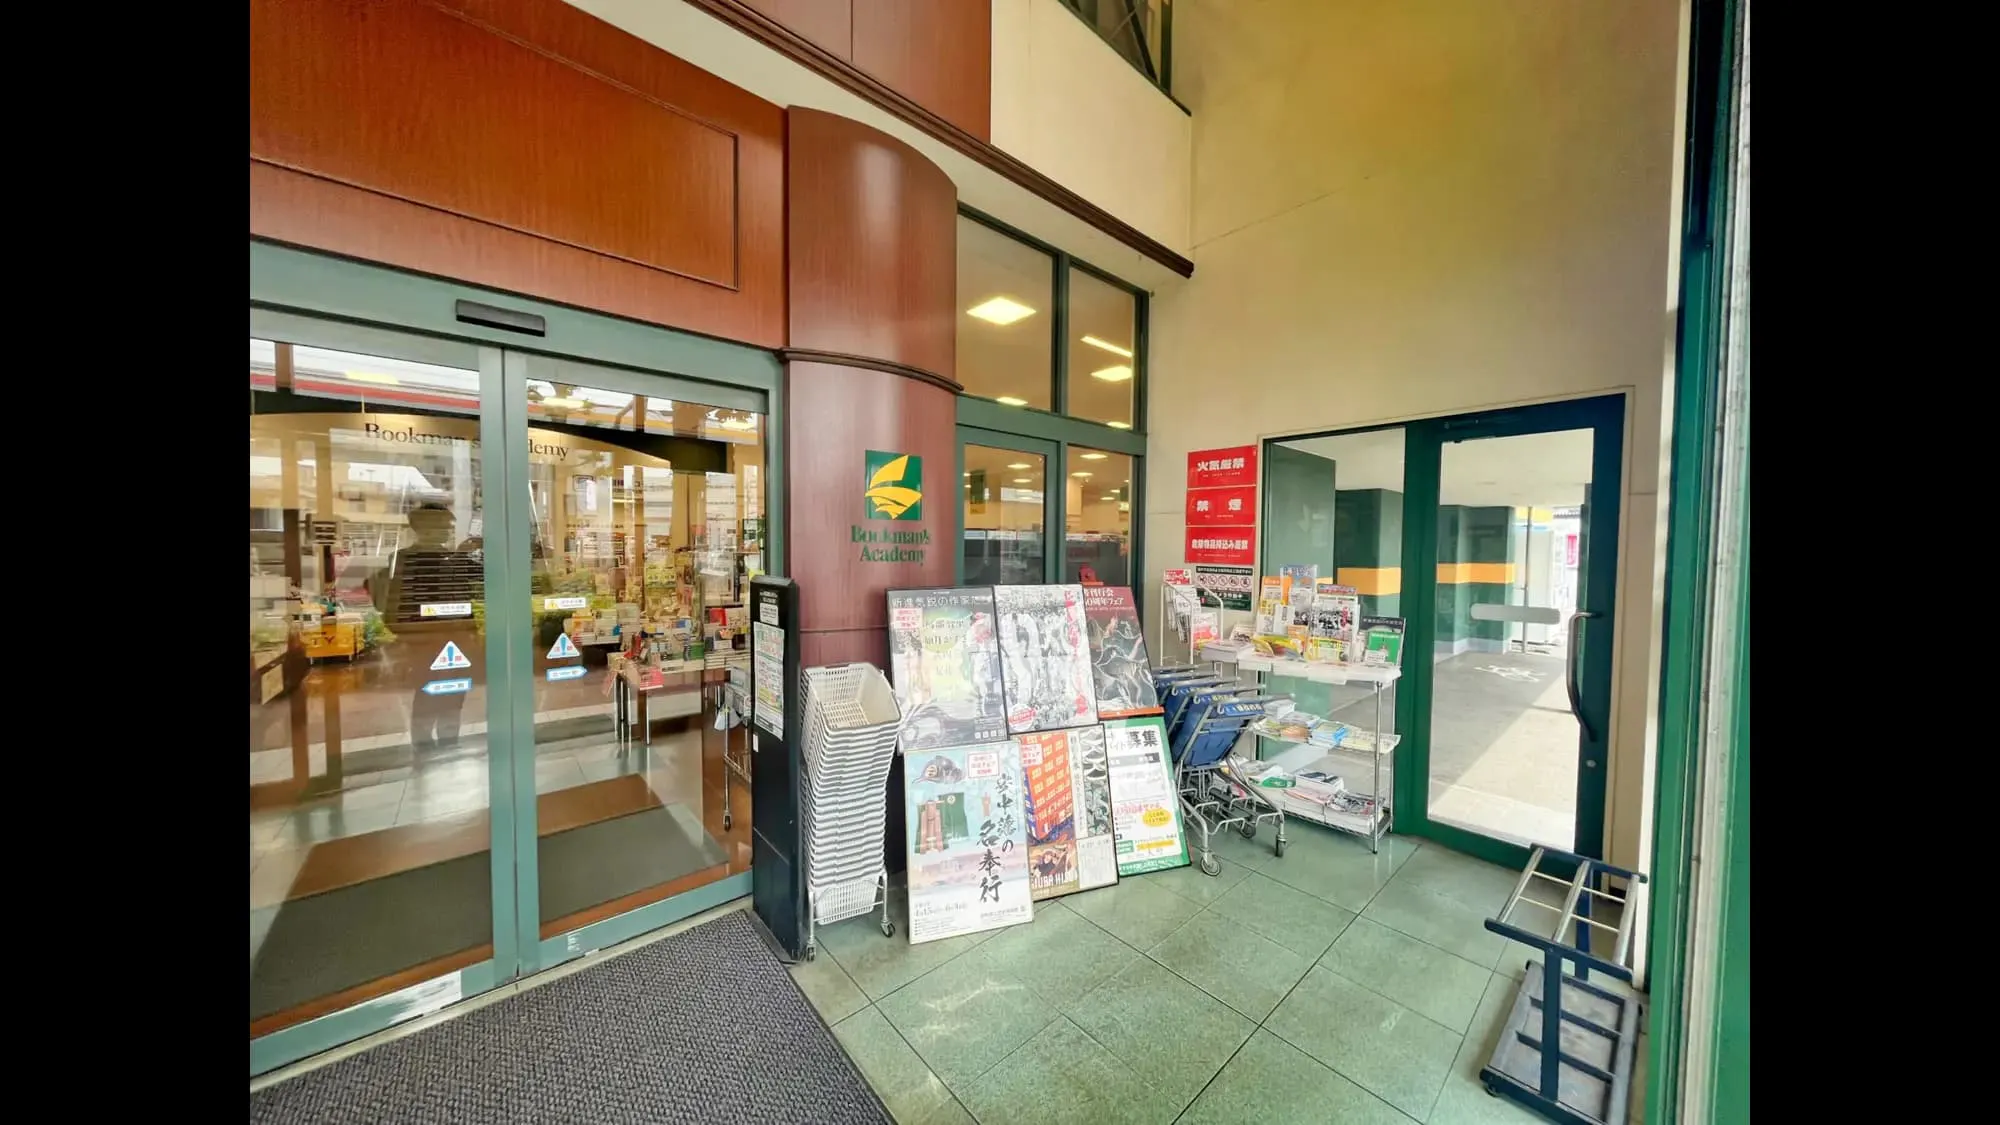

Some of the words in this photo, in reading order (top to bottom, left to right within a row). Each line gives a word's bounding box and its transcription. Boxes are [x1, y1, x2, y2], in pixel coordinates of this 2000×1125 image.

[364, 422, 480, 449] Bookmans
[528, 438, 569, 461] demy
[1197, 457, 1245, 472] 火気厳禁
[851, 524, 931, 544] Bookman's
[860, 545, 925, 567] Academy
[1127, 730, 1158, 747] 募集
[995, 773, 1017, 852] 安中藩の
[976, 820, 1003, 903] 名奉行
